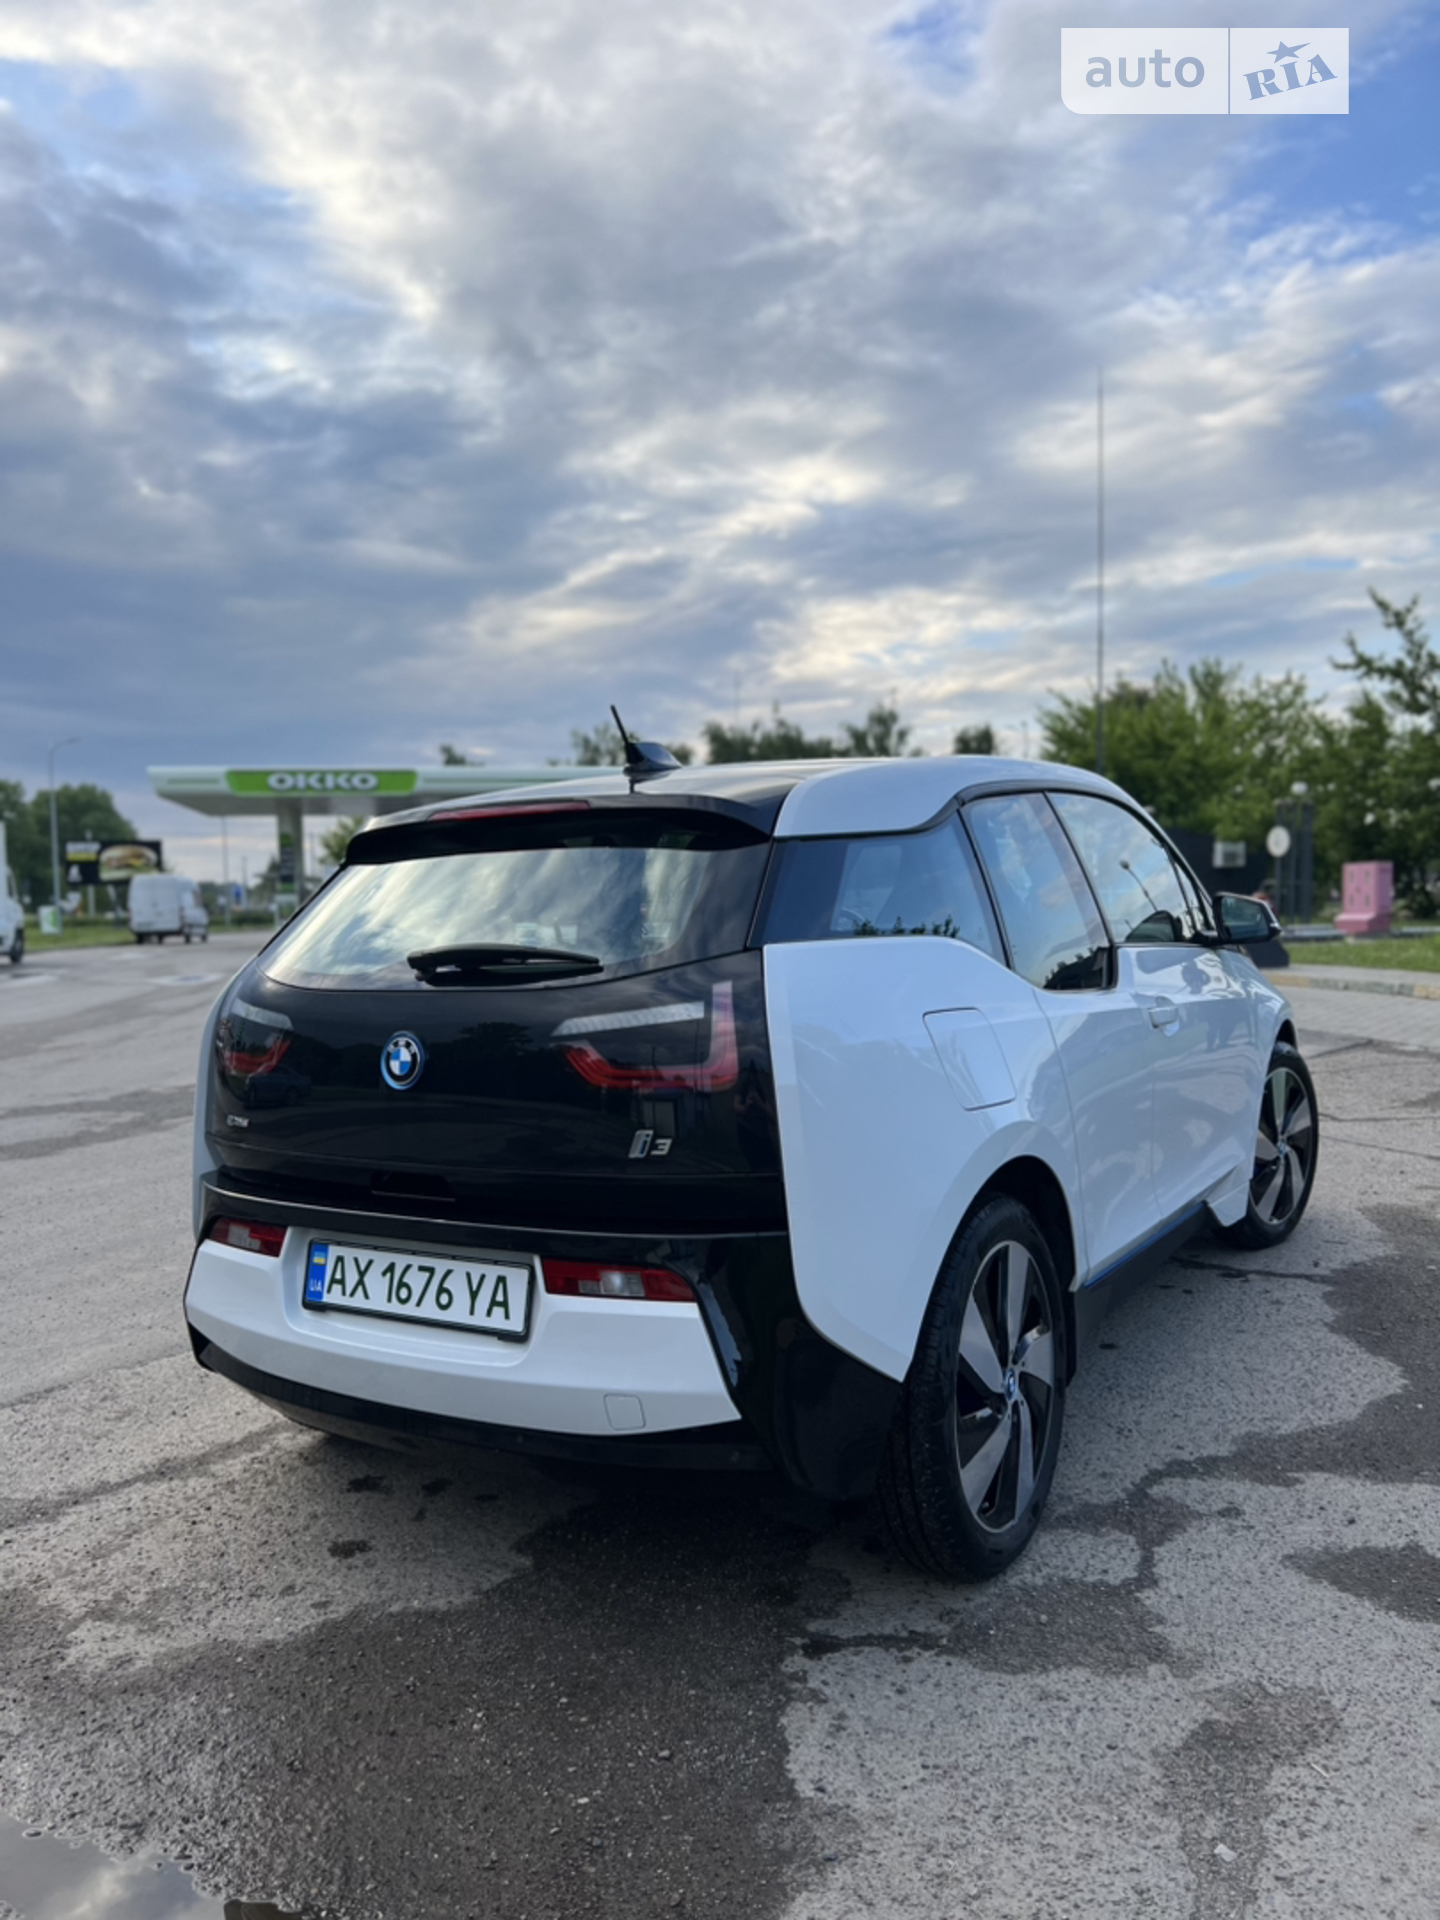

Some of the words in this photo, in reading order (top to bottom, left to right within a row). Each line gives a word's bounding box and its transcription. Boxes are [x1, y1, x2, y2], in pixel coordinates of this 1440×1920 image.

[267, 772, 378, 791] OKKO
[326, 1254, 375, 1301] AX
[380, 1261, 455, 1312] 1676
[464, 1270, 511, 1320] YA
